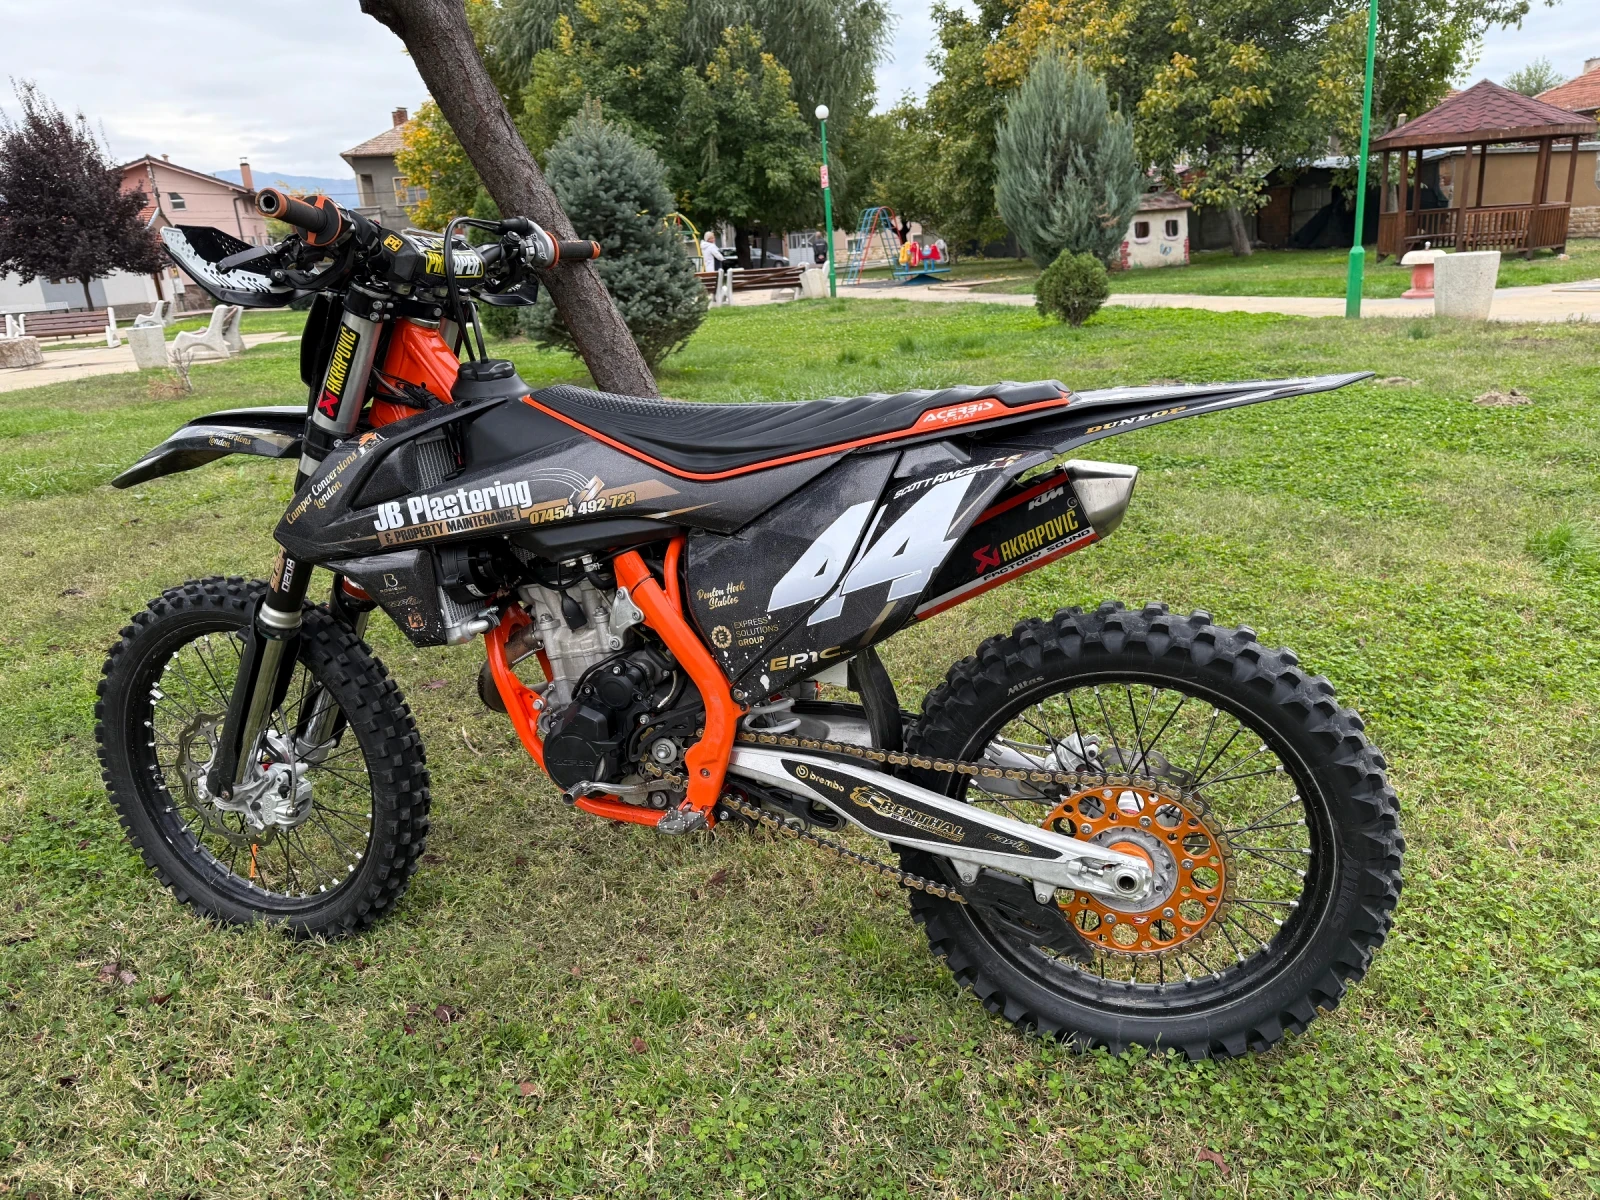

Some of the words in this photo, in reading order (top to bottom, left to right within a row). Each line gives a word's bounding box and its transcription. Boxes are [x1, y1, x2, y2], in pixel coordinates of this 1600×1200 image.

[1084, 406, 1187, 435] DUNLOP
[208, 435, 231, 448] London
[286, 493, 313, 525] Camper
[311, 450, 358, 496] Conversions
[313, 480, 343, 509] London
[893, 478, 934, 499] SCOTT
[1028, 486, 1065, 511] KTM
[373, 501, 405, 532] JB
[408, 480, 534, 525] Plastering
[529, 504, 574, 525] 07454
[577, 498, 606, 515] 492
[609, 491, 636, 508] 723
[394, 523, 444, 543] PROPERTY
[445, 508, 517, 534] MAINTENANCE
[767, 472, 958, 626] 44
[983, 551, 1042, 581] FACTORY
[1046, 529, 1091, 553] SOUND
[281, 557, 296, 593] 0208
[726, 581, 746, 594] Hook
[709, 594, 739, 610] Stables
[734, 616, 768, 629] EXPRESS
[735, 624, 779, 638] SOLUTIONS
[737, 635, 765, 647] GROUP
[1007, 675, 1045, 697] Mitas
[809, 773, 845, 793] brembo
[880, 800, 966, 836] RENTHAL
